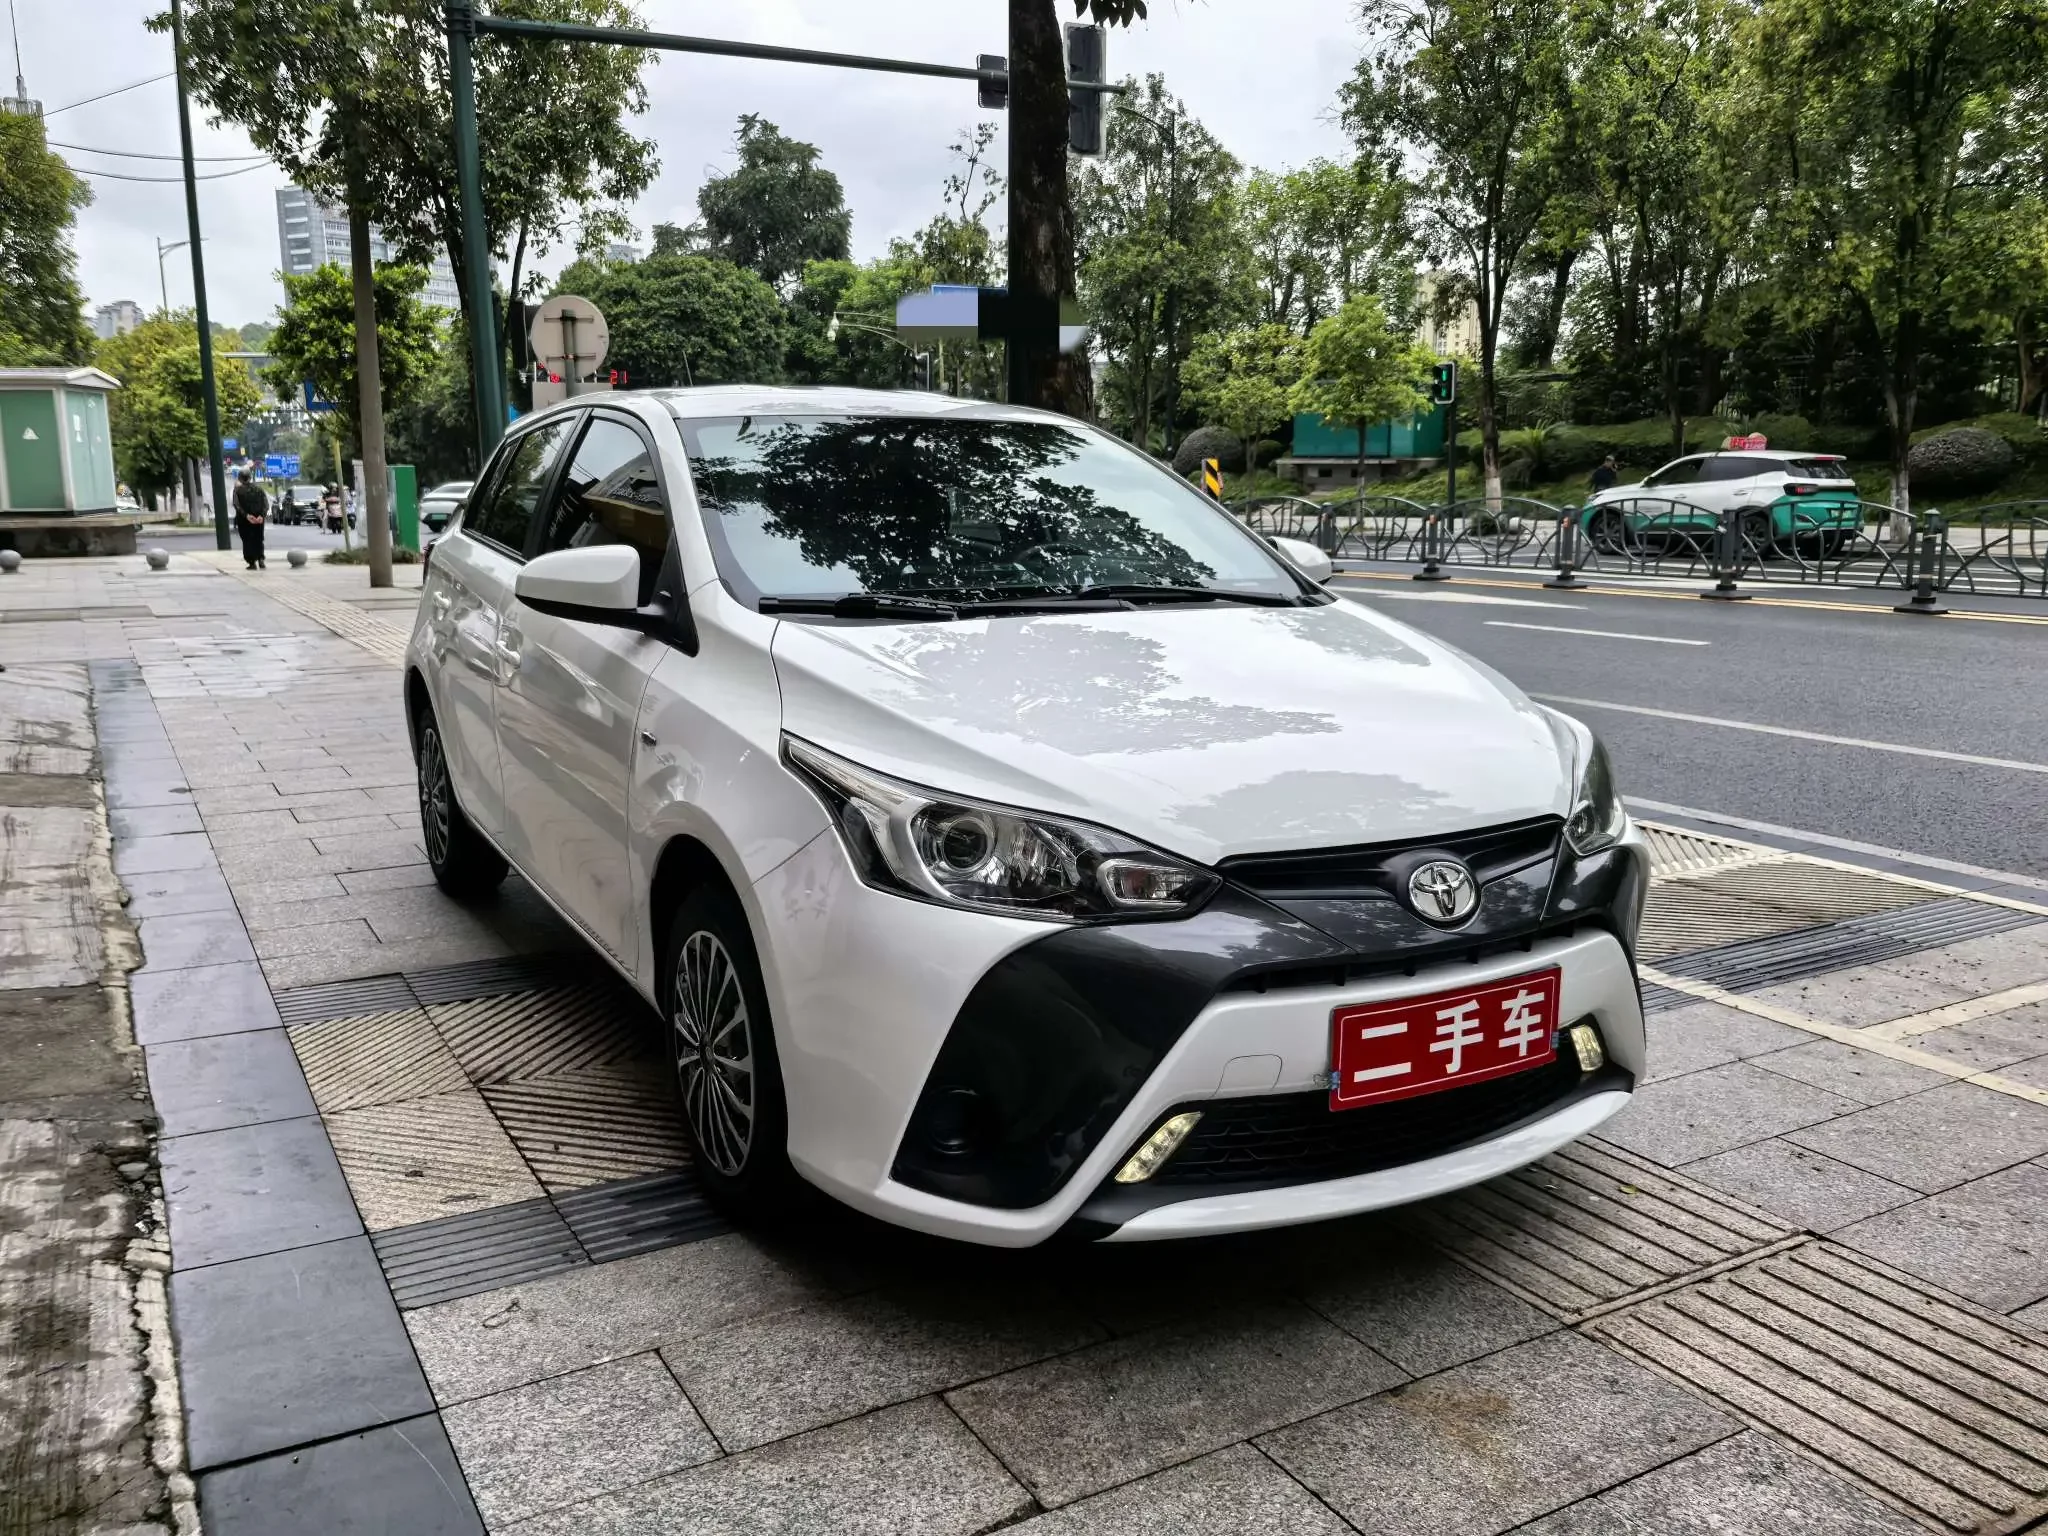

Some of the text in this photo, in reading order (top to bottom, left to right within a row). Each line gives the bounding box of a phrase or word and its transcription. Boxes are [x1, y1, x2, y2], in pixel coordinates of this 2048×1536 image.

[609, 369, 628, 385] 21
[1354, 989, 1545, 1083] 二手车
